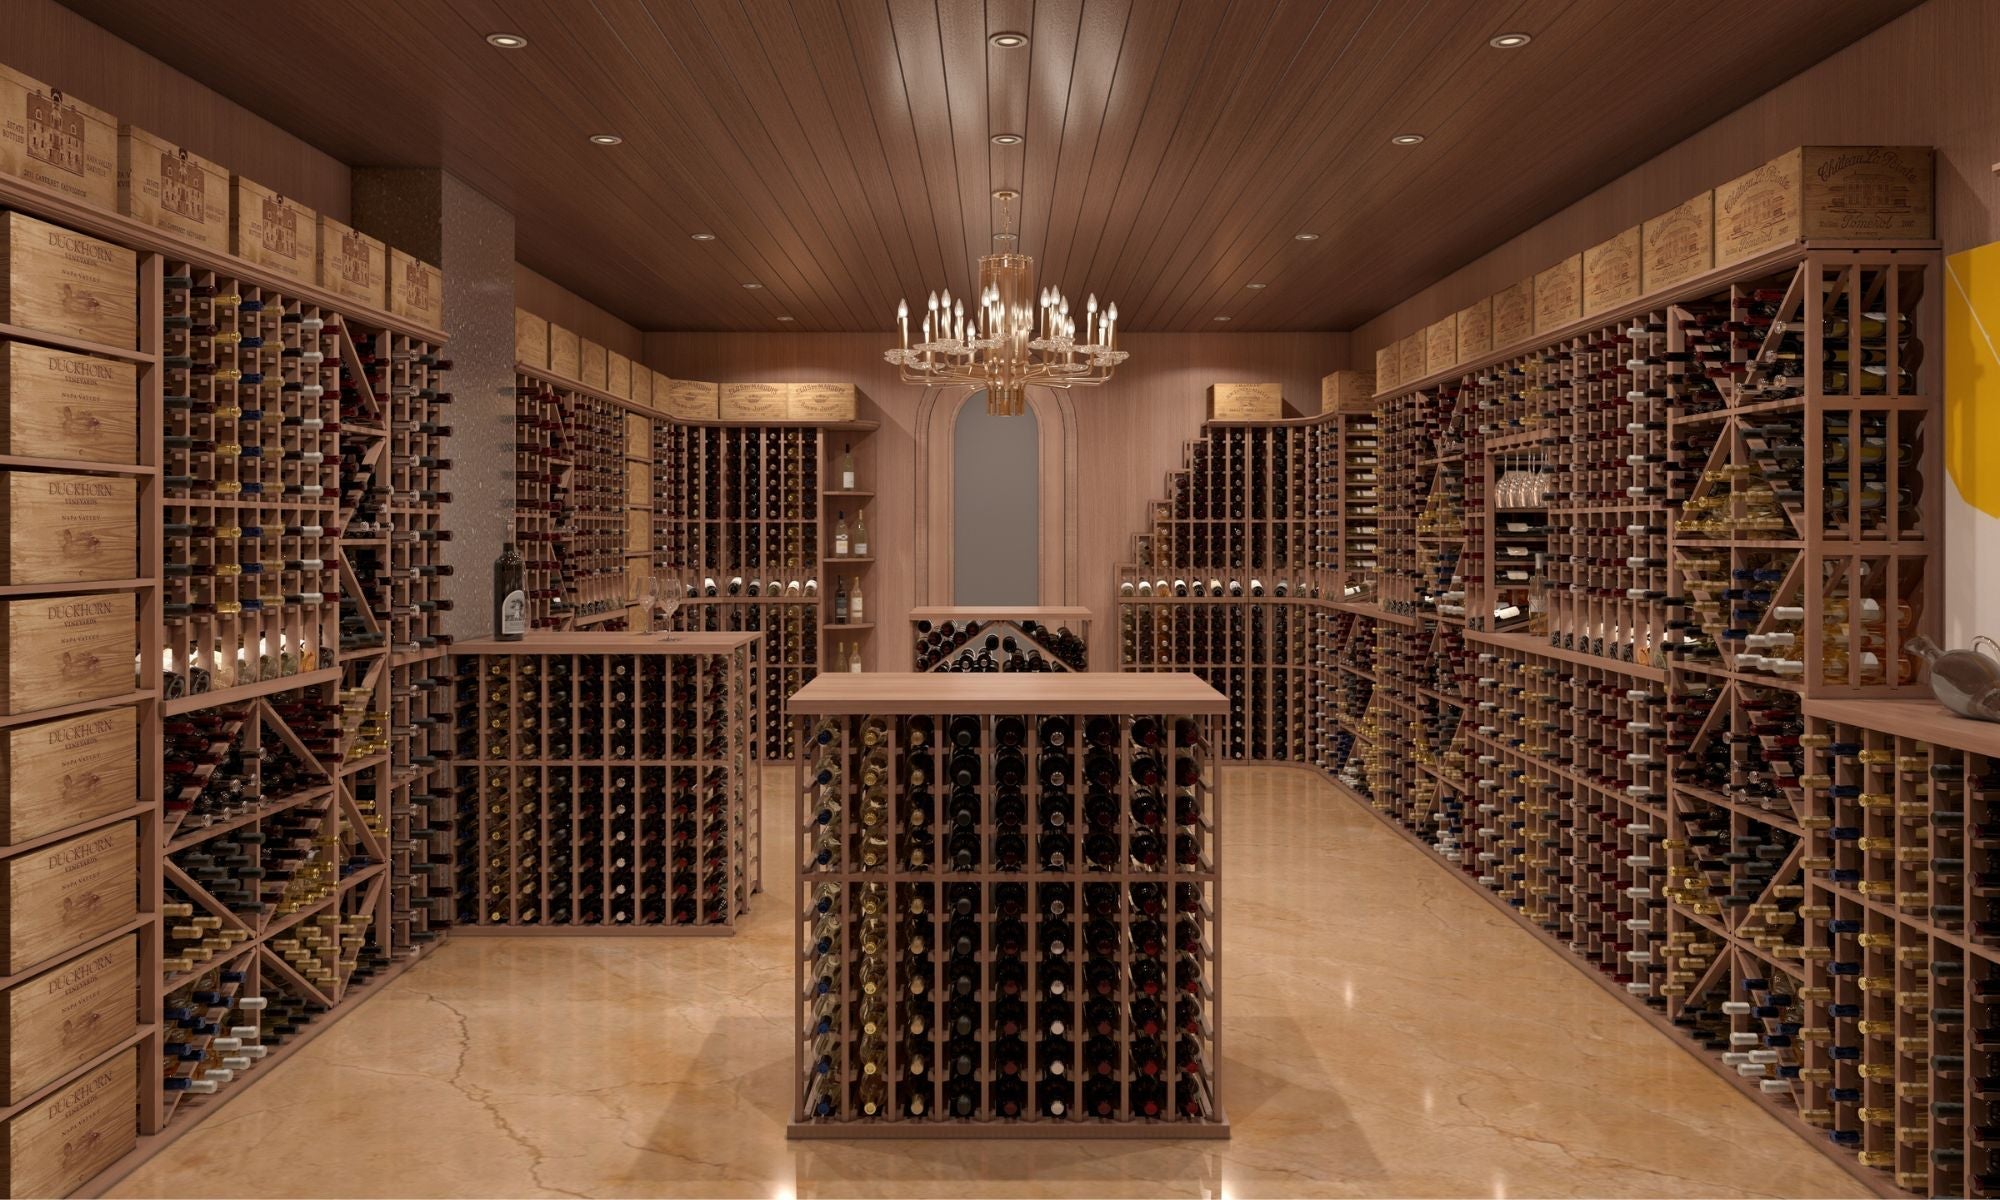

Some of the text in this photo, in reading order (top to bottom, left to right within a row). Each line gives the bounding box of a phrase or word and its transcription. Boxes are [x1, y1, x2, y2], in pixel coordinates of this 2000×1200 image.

[48, 232, 113, 262] DUCKHORN
[48, 357, 113, 379] DUCKHORN
[48, 482, 113, 497] DUCKHORN
[48, 602, 113, 620] DUCKHORN
[48, 719, 113, 745] DUCKHORN
[48, 834, 113, 869] DUCKHORN
[48, 953, 113, 994] DUCKHORN
[48, 1070, 113, 1119] DUCKHORN
